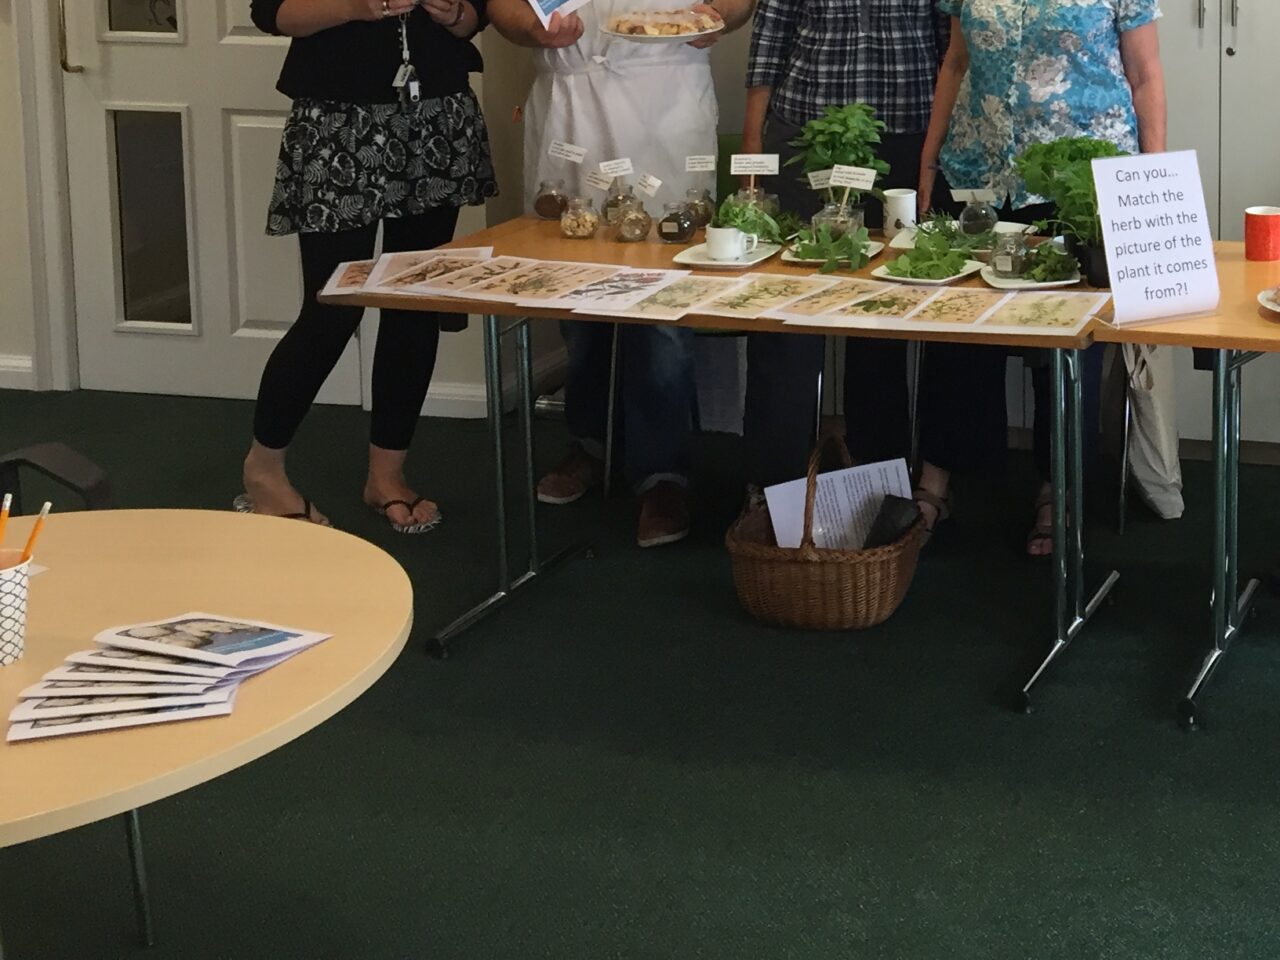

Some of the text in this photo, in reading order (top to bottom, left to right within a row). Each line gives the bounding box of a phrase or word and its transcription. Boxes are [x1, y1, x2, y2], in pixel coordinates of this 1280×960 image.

[1115, 167, 1179, 183] Can you...
[1118, 189, 1184, 208] Match the
[1111, 211, 1198, 233] herb with the
[1115, 234, 1202, 259] picture of the
[1116, 257, 1208, 283] plant it comes
[1144, 282, 1189, 301] from?!
